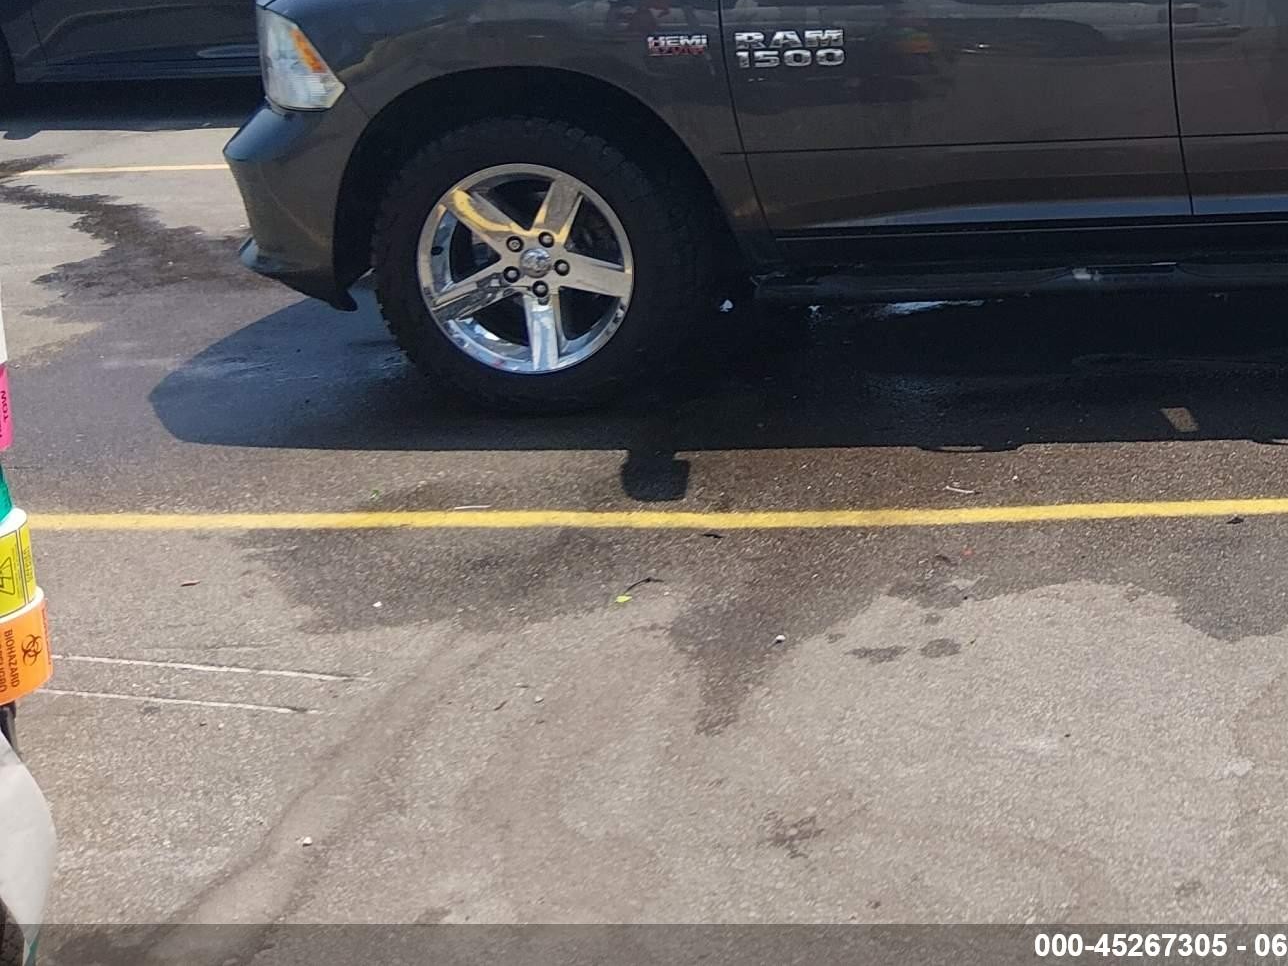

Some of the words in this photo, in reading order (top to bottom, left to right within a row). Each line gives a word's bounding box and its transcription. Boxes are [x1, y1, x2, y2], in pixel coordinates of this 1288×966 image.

[647, 34, 708, 49] HEMI
[734, 29, 844, 50] RAM
[735, 48, 846, 69] 1500
[4, 628, 20, 688] BIOHAZARD
